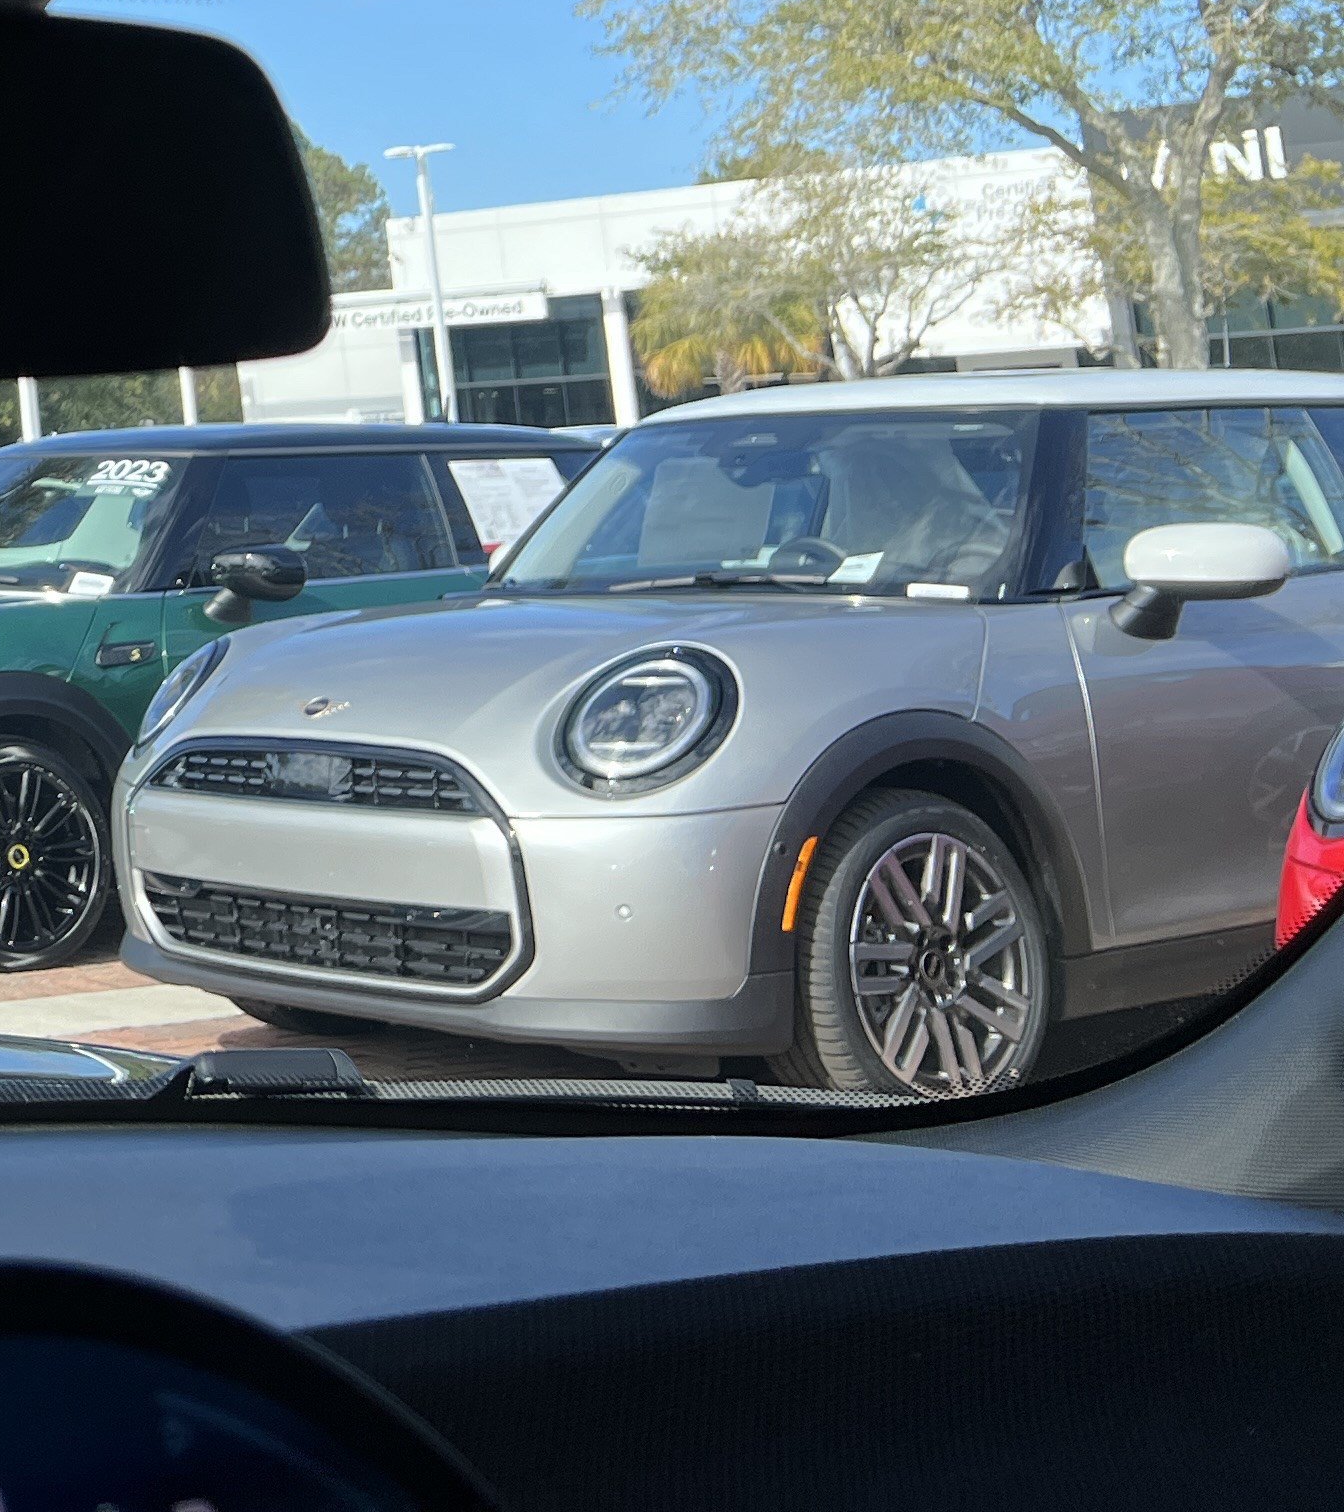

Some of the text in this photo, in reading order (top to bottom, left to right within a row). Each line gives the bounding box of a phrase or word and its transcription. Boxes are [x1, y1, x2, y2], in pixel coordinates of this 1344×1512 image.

[352, 307, 422, 327] Certified
[426, 299, 523, 321] Pe-Owned
[90, 459, 170, 483] 2023
